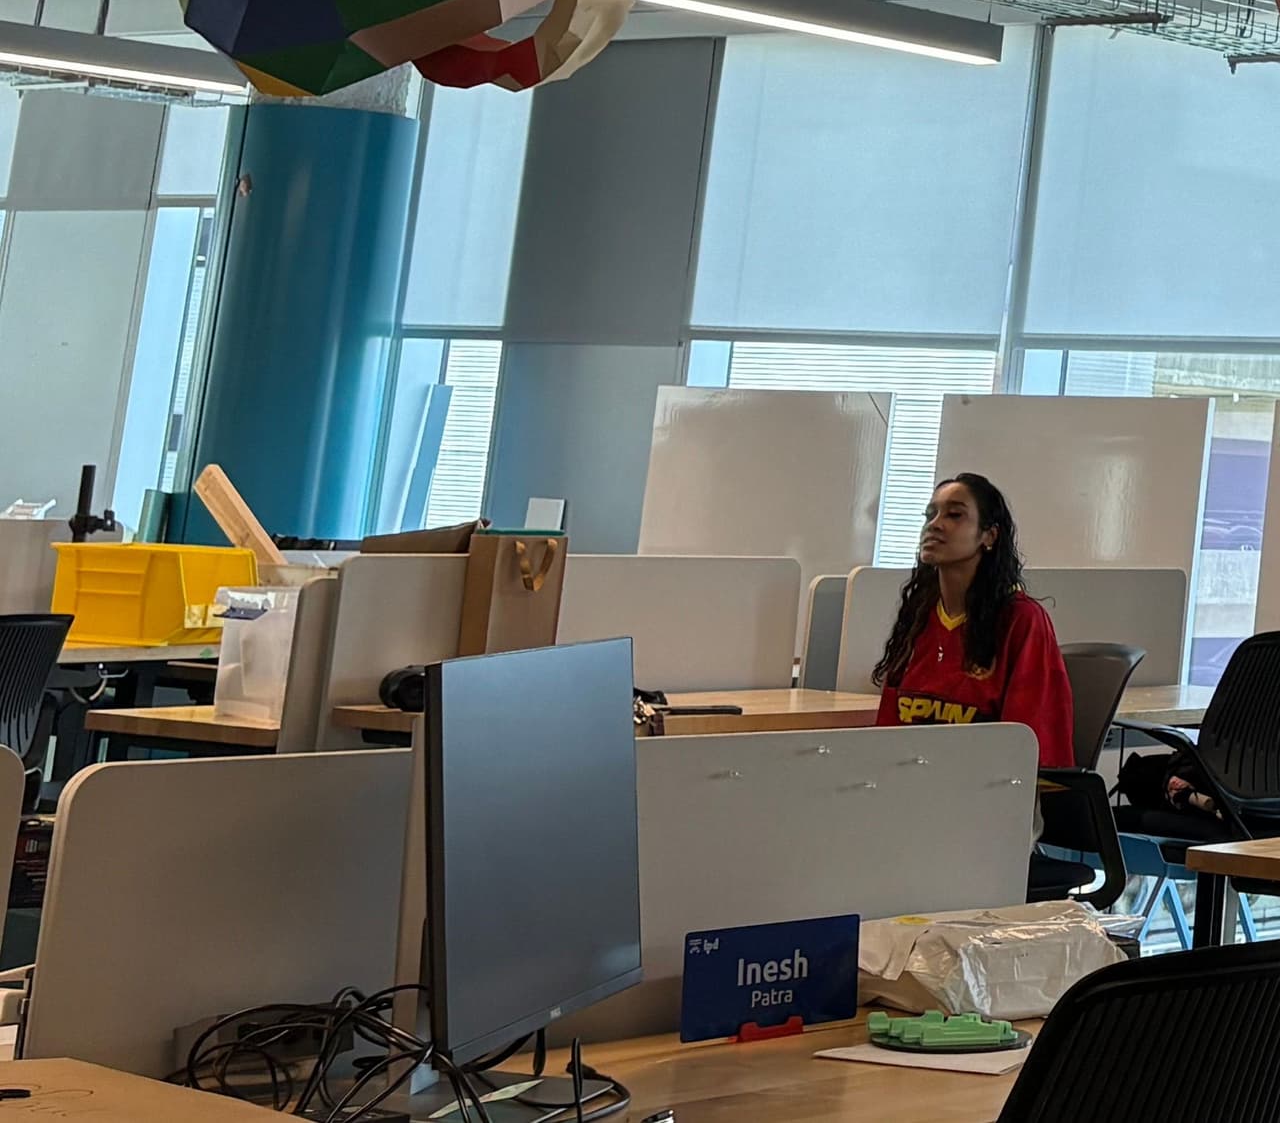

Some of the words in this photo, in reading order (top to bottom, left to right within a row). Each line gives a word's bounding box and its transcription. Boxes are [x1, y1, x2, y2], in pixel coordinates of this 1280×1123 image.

[898, 696, 977, 724] SPAIN
[737, 948, 808, 986] Inesh
[751, 988, 793, 1008] Patra
